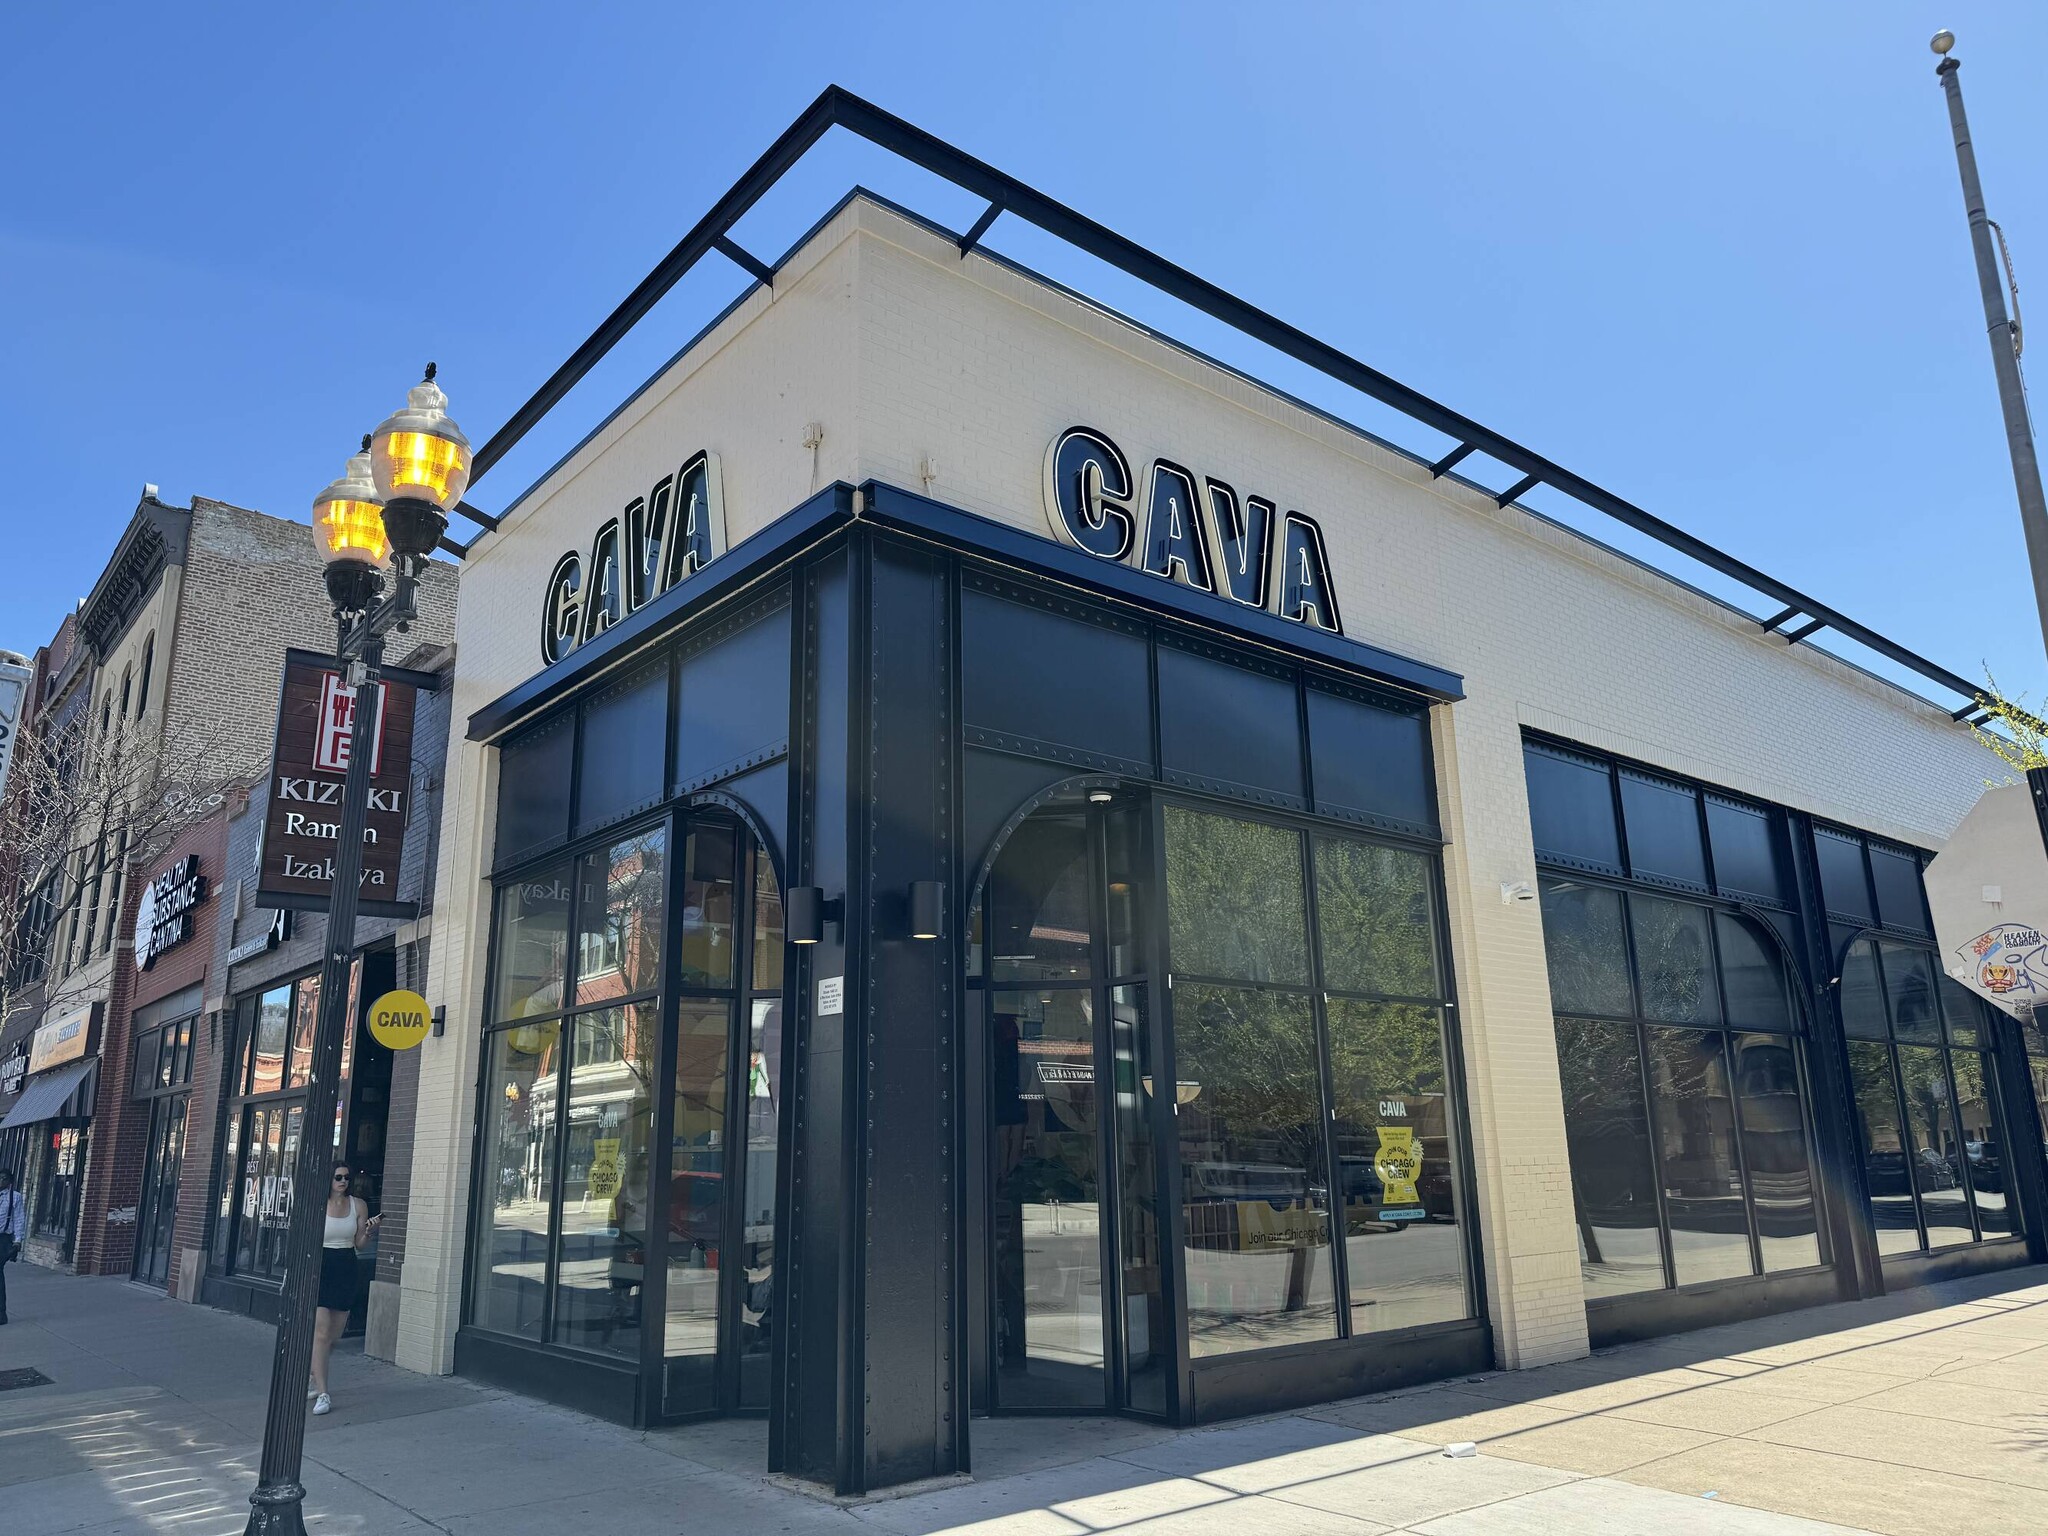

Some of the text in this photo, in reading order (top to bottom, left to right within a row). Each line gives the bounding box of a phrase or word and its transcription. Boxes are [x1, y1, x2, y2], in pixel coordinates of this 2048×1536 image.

[1044, 426, 1344, 636] CAVA
[541, 449, 727, 666] CAVA
[277, 776, 401, 812] KIZKI
[284, 812, 378, 844] Ramn
[155, 854, 190, 899] HEALTHY
[282, 854, 385, 887] Izakya
[152, 875, 197, 927] SUBSTANCE
[149, 914, 184, 957] CANTINA
[2003, 930, 2040, 941] HEAVEN
[377, 1011, 424, 1028] CAVA
[1379, 1101, 1407, 1117] CAVA
[598, 1111, 618, 1128] CAVA
[1386, 1146, 1397, 1158] JOIN
[1397, 1146, 1408, 1157] OUR
[246, 1160, 260, 1174] BEST
[1380, 1158, 1415, 1169] CHICAGO
[592, 1172, 618, 1184] CHICAGO
[1387, 1169, 1410, 1180] CREW
[596, 1183, 613, 1195] CREW
[1248, 1232, 1266, 1245] Join
[1267, 1233, 1284, 1243] our
[1284, 1227, 1320, 1242] Chicago
